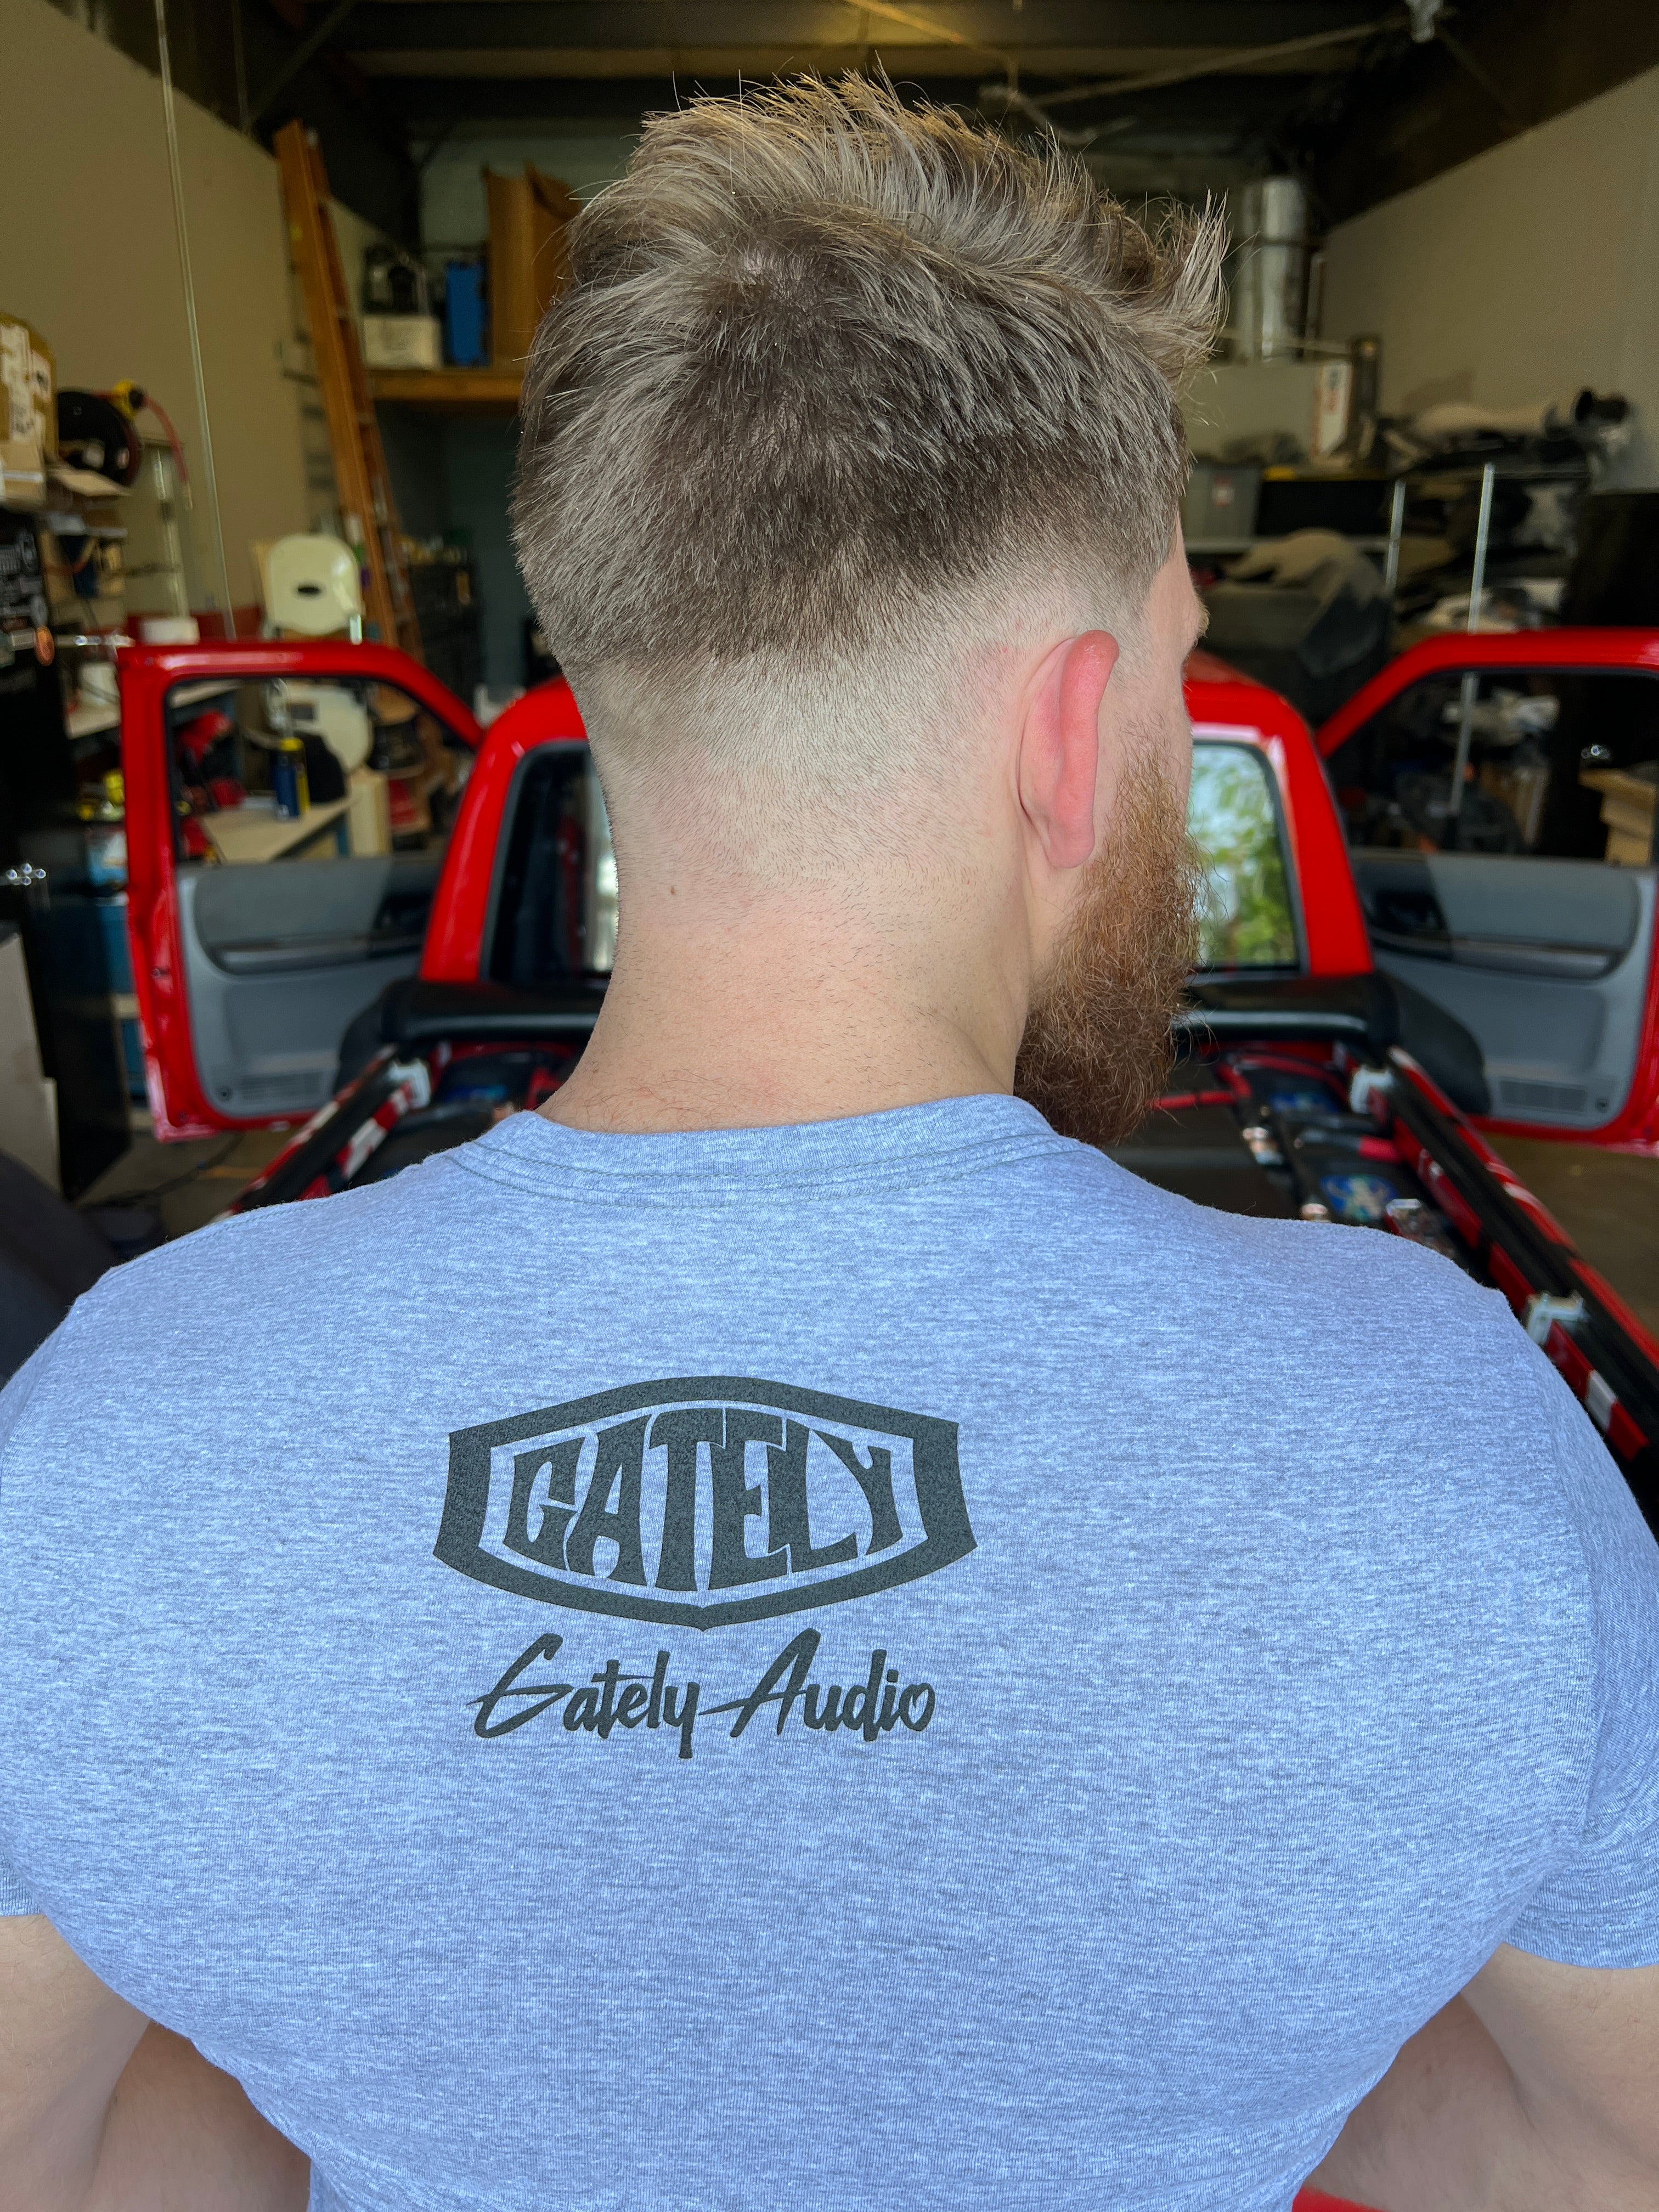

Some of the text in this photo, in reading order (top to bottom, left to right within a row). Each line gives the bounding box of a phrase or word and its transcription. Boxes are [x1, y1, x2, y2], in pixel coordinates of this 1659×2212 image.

[502, 1407, 904, 1592] GATELY
[466, 1628, 936, 1760] Gately Audio
